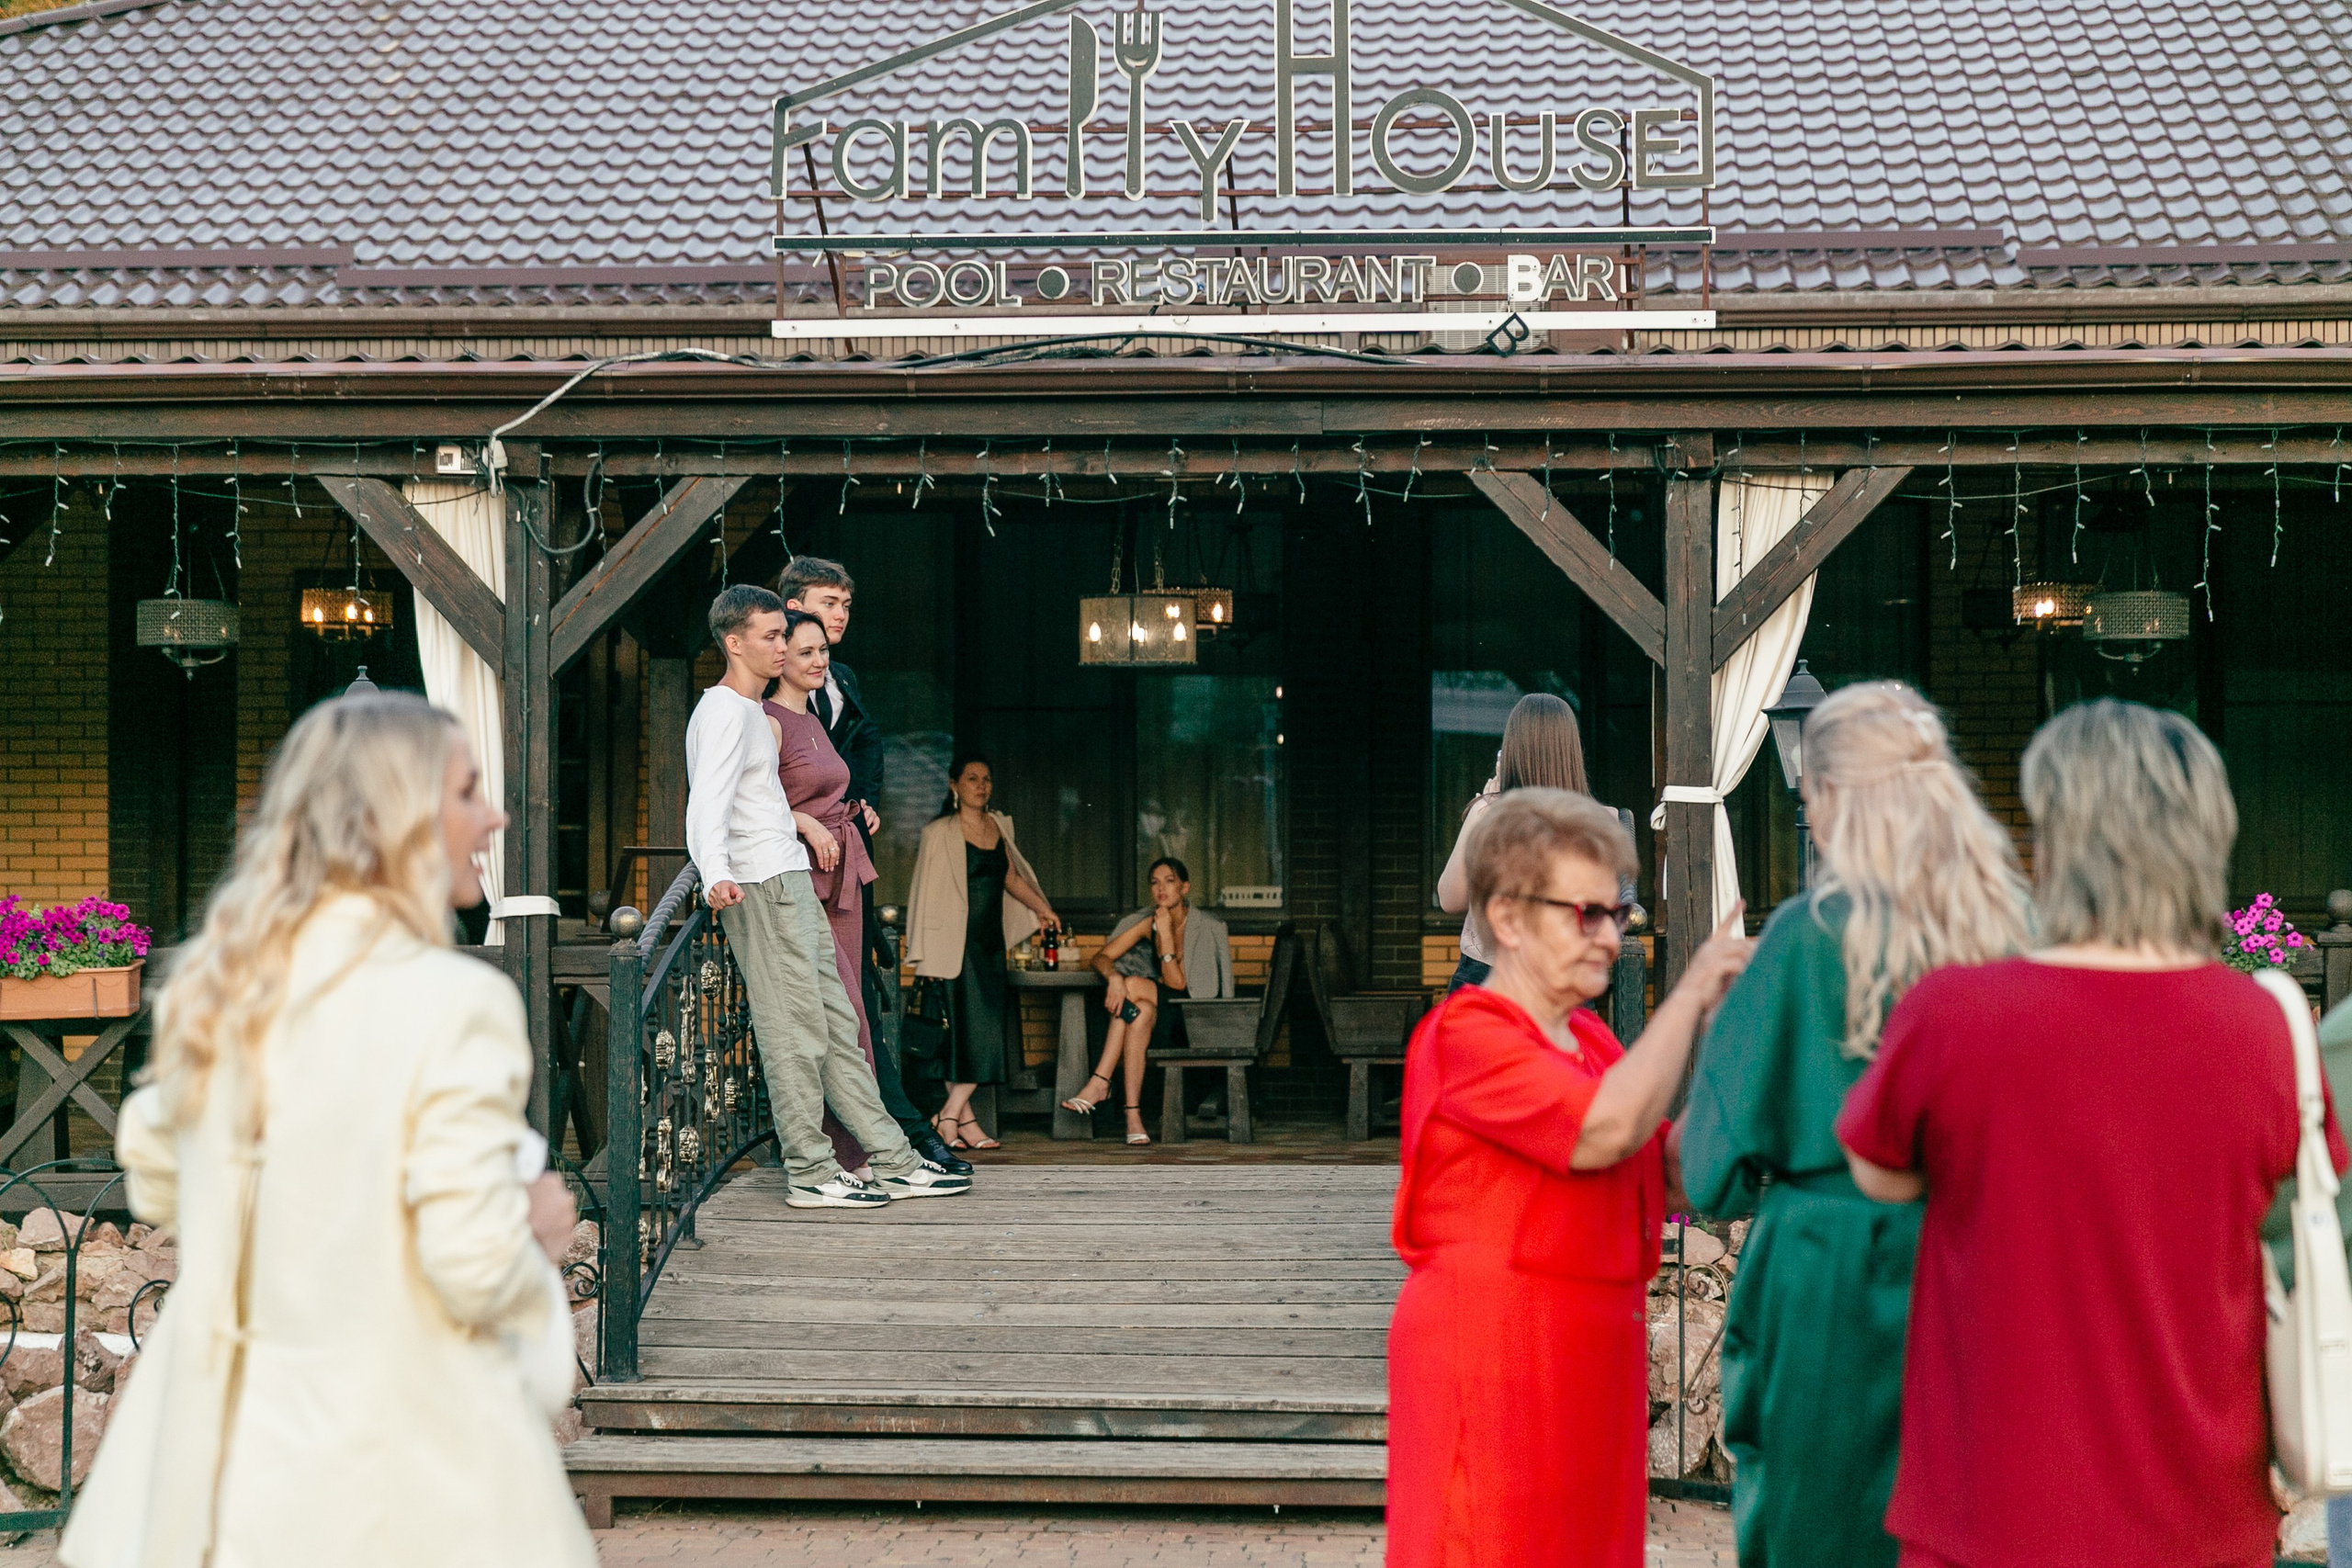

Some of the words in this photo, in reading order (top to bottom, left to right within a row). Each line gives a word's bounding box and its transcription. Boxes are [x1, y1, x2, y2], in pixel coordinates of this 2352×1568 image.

[864, 261, 1022, 310] POOL
[1091, 255, 1436, 306] RESTAURANT
[1508, 254, 1618, 301] BAR
